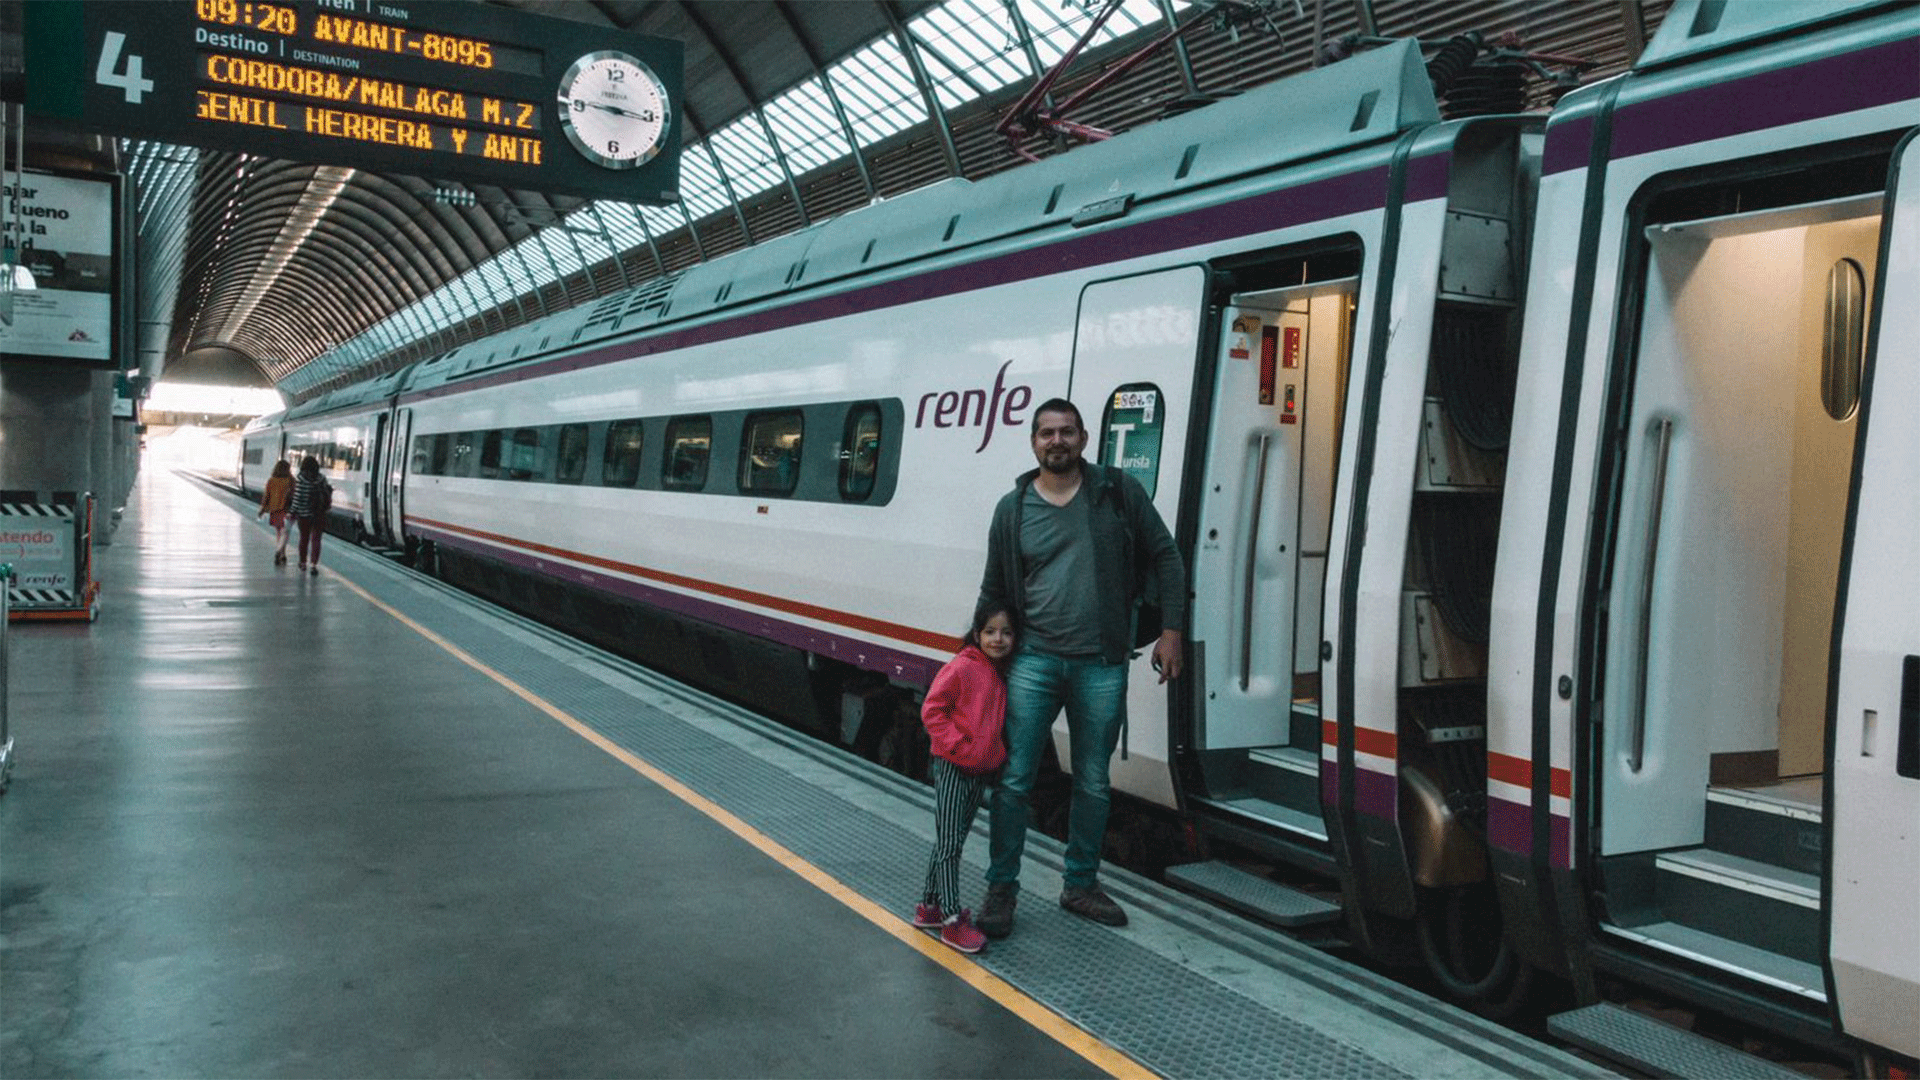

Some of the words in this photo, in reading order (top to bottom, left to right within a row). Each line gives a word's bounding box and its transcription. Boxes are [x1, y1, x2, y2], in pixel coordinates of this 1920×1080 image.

[379, 6, 408, 20] TRAIN
[197, 0, 297, 36] 09:20
[314, 13, 493, 70] AVANT-8095
[195, 27, 269, 54] Destino
[293, 49, 360, 70] DESTINATION
[96, 31, 154, 104] 4
[607, 68, 625, 83] 12
[207, 54, 467, 119] CORDOBA/MALAGA
[573, 99, 585, 113] 9
[643, 109, 654, 123] 3
[306, 106, 432, 150] HERRERA
[452, 129, 468, 154] Y
[607, 140, 620, 154] 6
[10, 199, 69, 220] bueno
[31, 220, 47, 235] la
[914, 359, 1032, 454] renfe
[1110, 423, 1150, 469] Turista
[0, 530, 54, 544] tendo
[25, 573, 66, 586] renfe
